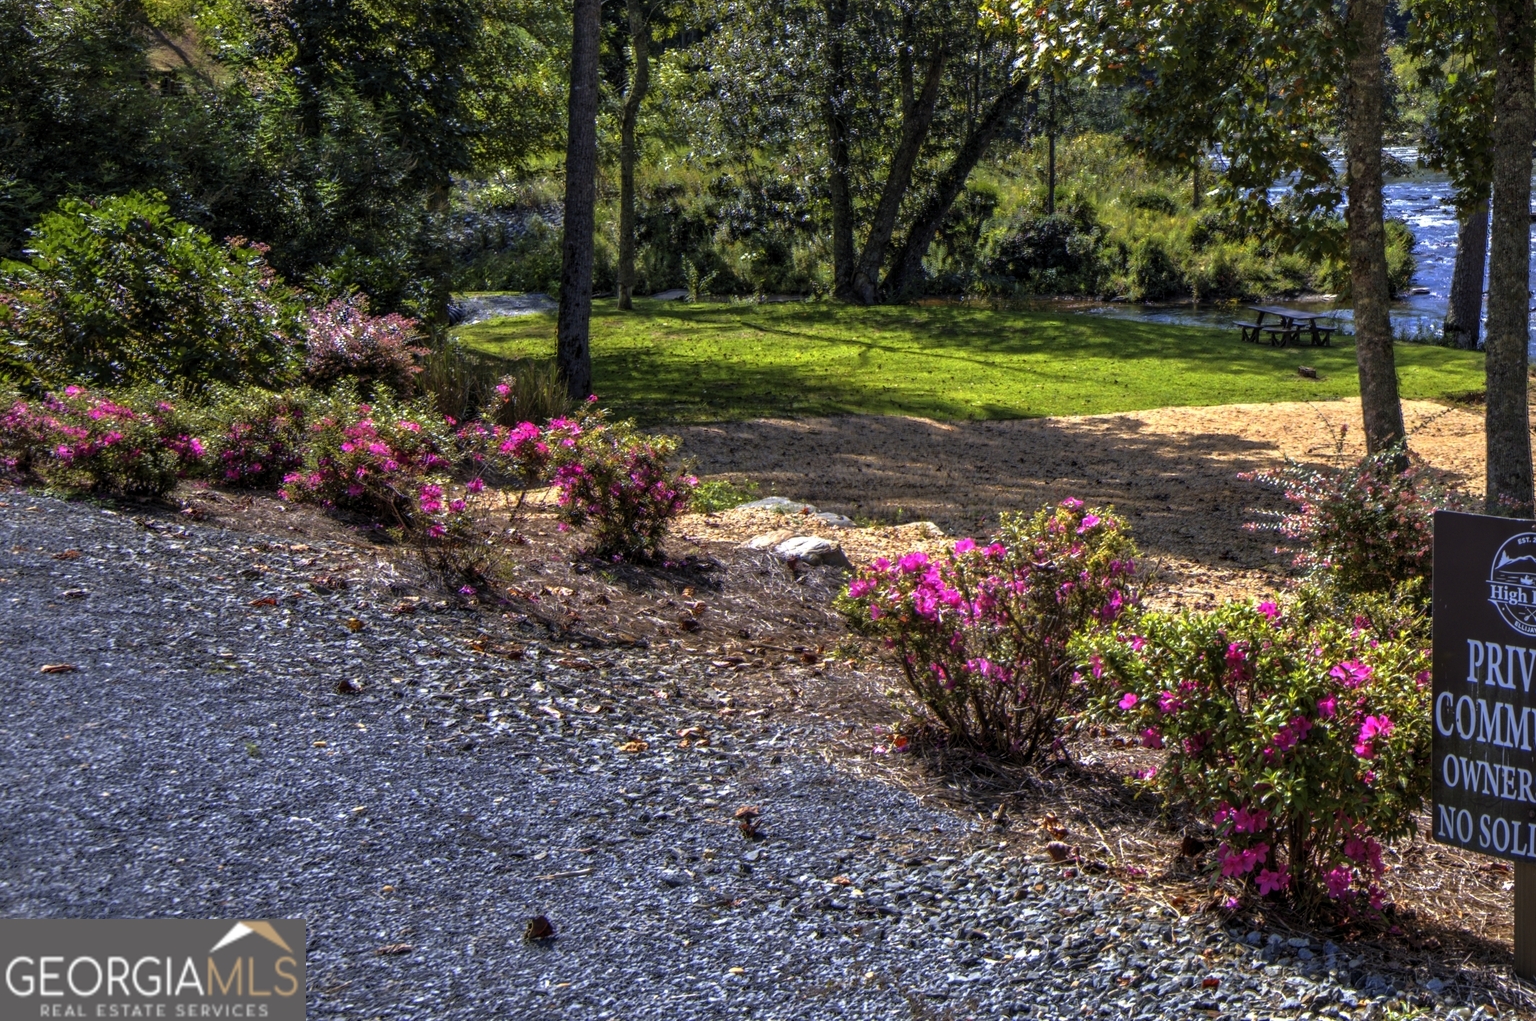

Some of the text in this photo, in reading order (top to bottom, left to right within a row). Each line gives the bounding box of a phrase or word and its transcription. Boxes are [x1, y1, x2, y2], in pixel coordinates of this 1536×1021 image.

[1517, 536, 1532, 545] EST.
[1490, 584, 1528, 605] High
[1438, 804, 1473, 843] NO
